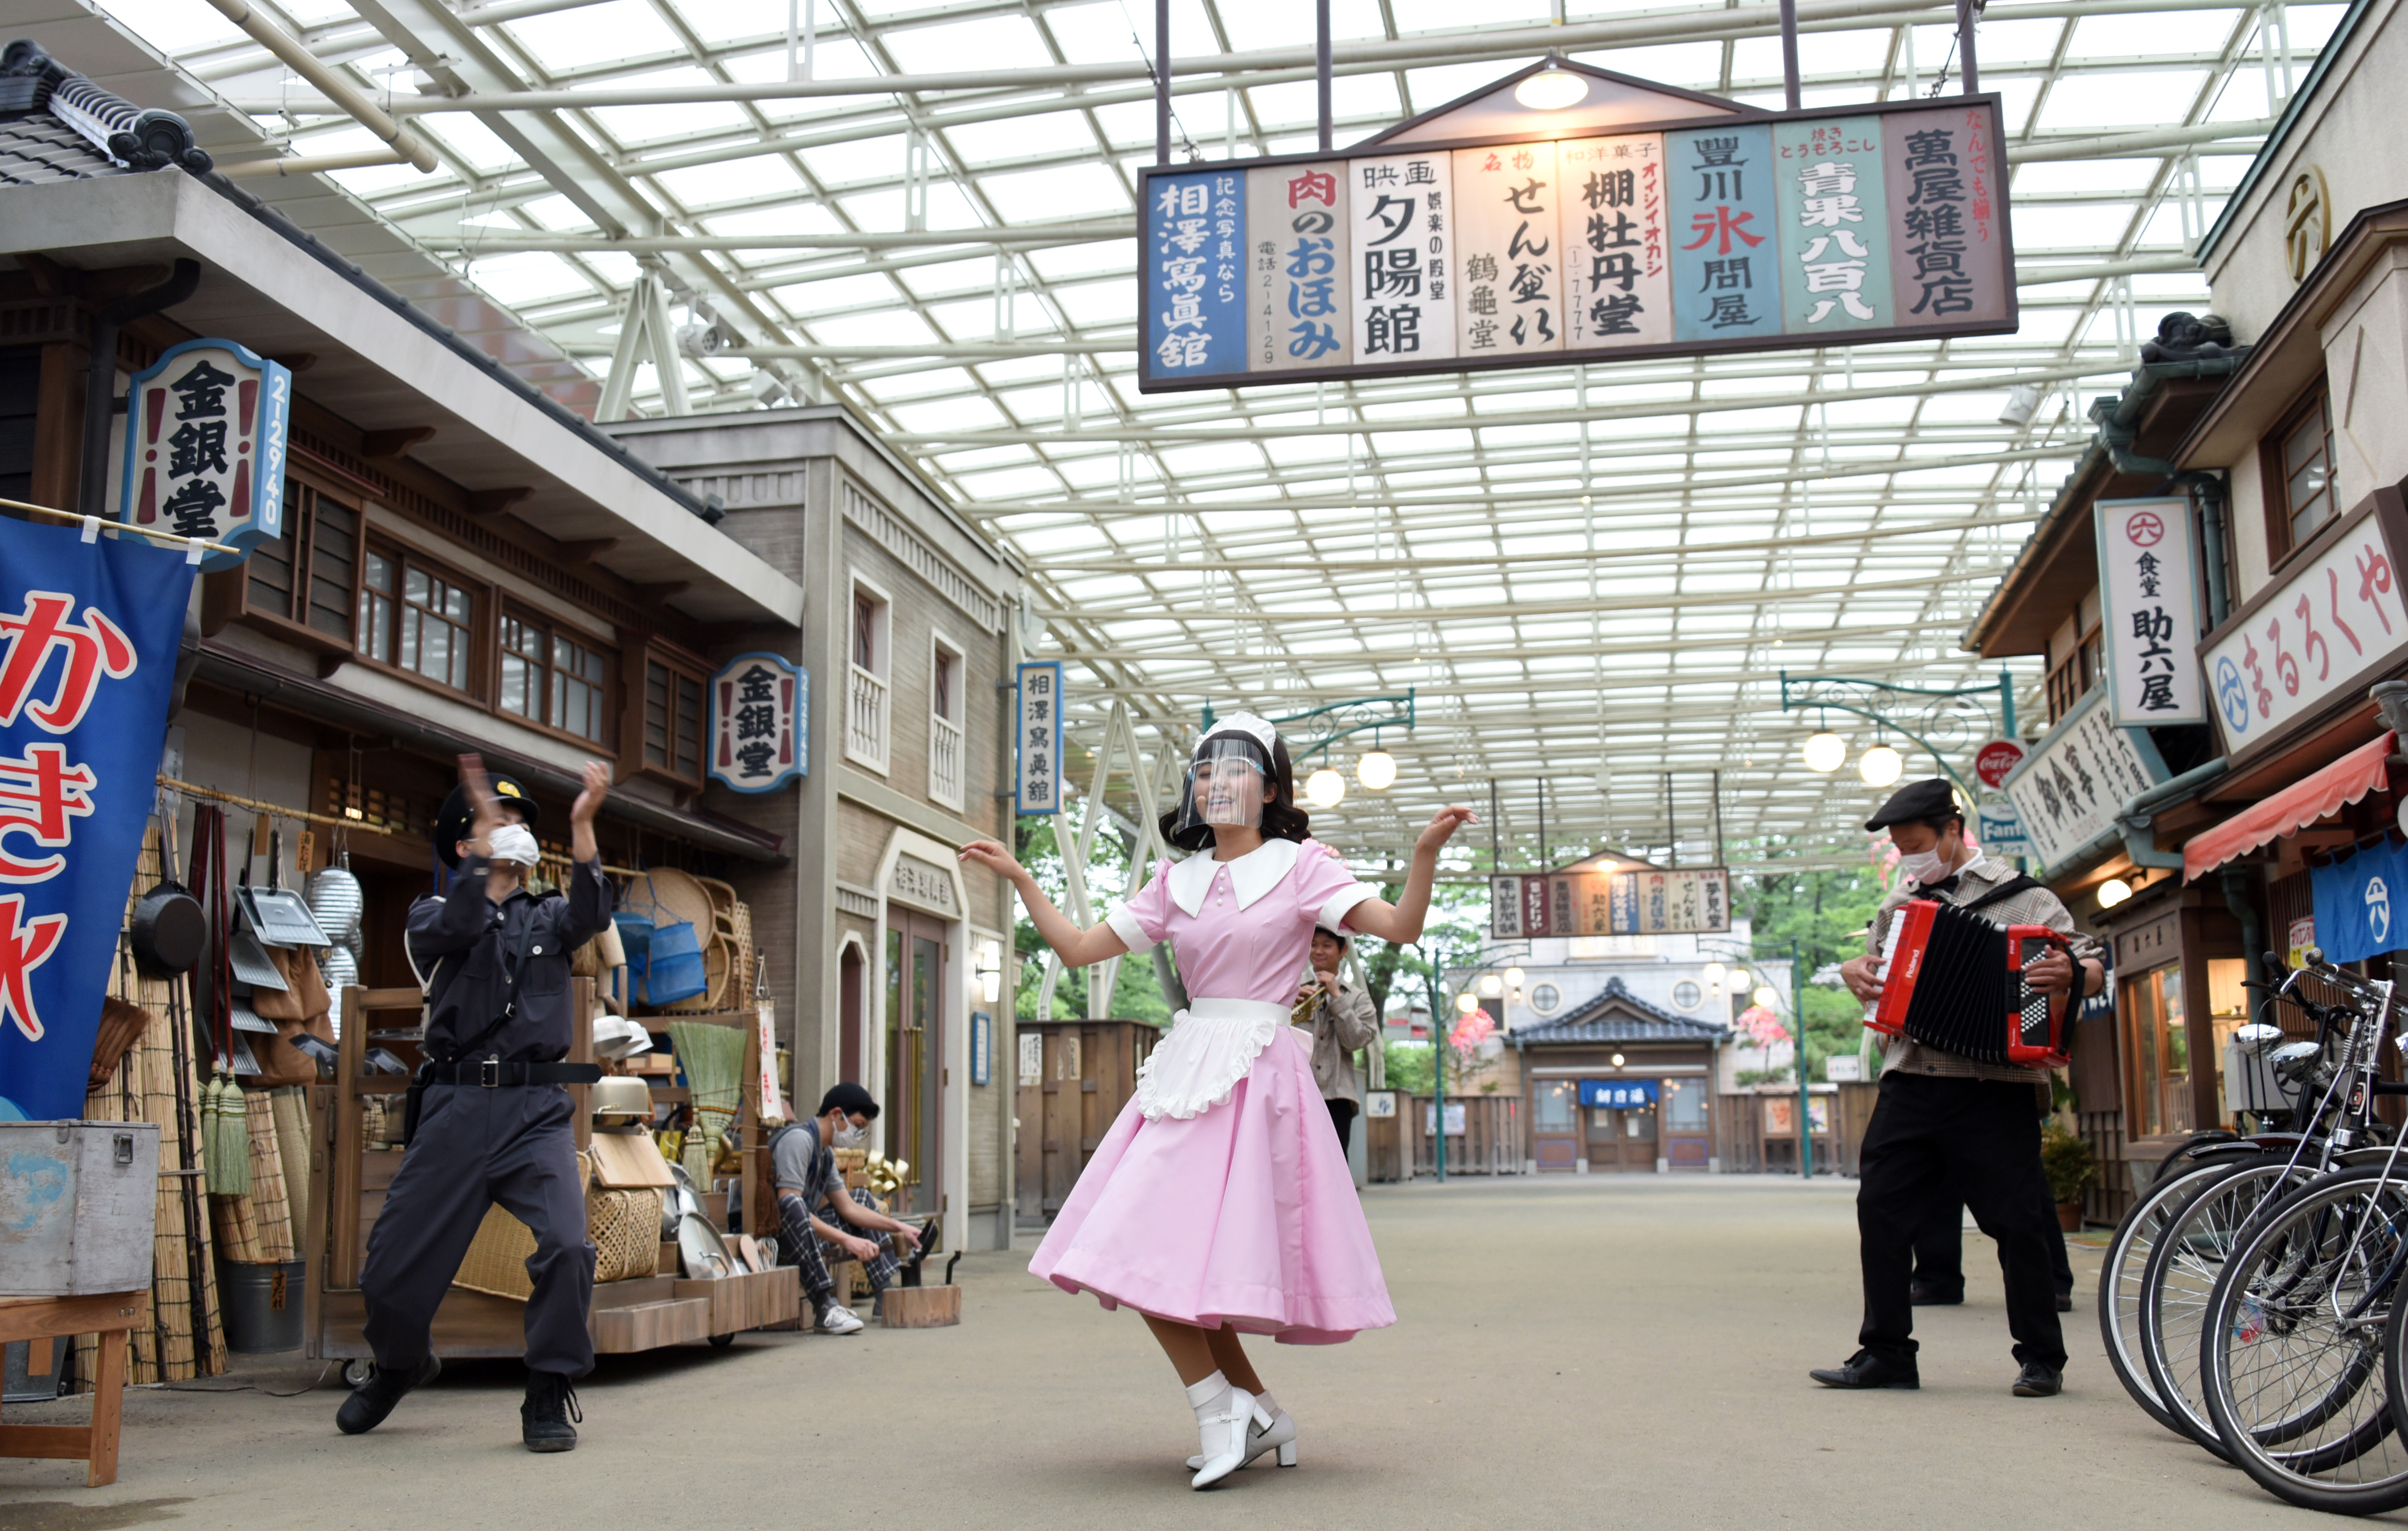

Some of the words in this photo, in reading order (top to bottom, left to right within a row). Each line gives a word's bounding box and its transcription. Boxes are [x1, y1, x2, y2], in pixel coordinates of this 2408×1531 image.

[1364, 161, 1437, 189] 映画
[1481, 150, 1534, 172] 名物
[1564, 142, 1658, 164] 和洋菓子
[1781, 138, 1876, 158] とうもろこし
[1811, 127, 1843, 141] 焼き
[1967, 110, 1990, 242] なんでも揃う
[1215, 176, 1236, 303] 記念写真なら
[1286, 170, 1341, 360] 肉のおほみ
[1363, 194, 1422, 355] 夕陽館
[1427, 191, 1444, 301] 娯楽の殿堂
[1582, 168, 1645, 337] 棚牡丹堂
[1641, 162, 1663, 278] オイシイオカシ
[1797, 162, 1875, 325] 青果八百八
[1904, 129, 1973, 316] 萬屋雑貨店
[163, 360, 235, 538] 金銀堂
[265, 376, 285, 524] 2-2940
[2135, 551, 2162, 598] 食堂
[2132, 606, 2179, 711] 助六屋
[2243, 544, 2391, 719] まるろくや
[735, 665, 778, 778] 金銀堂
[1982, 820, 2023, 841] Fant
[1905, 949, 1920, 978] Roland
[273, 1272, 285, 1309] すだれ
